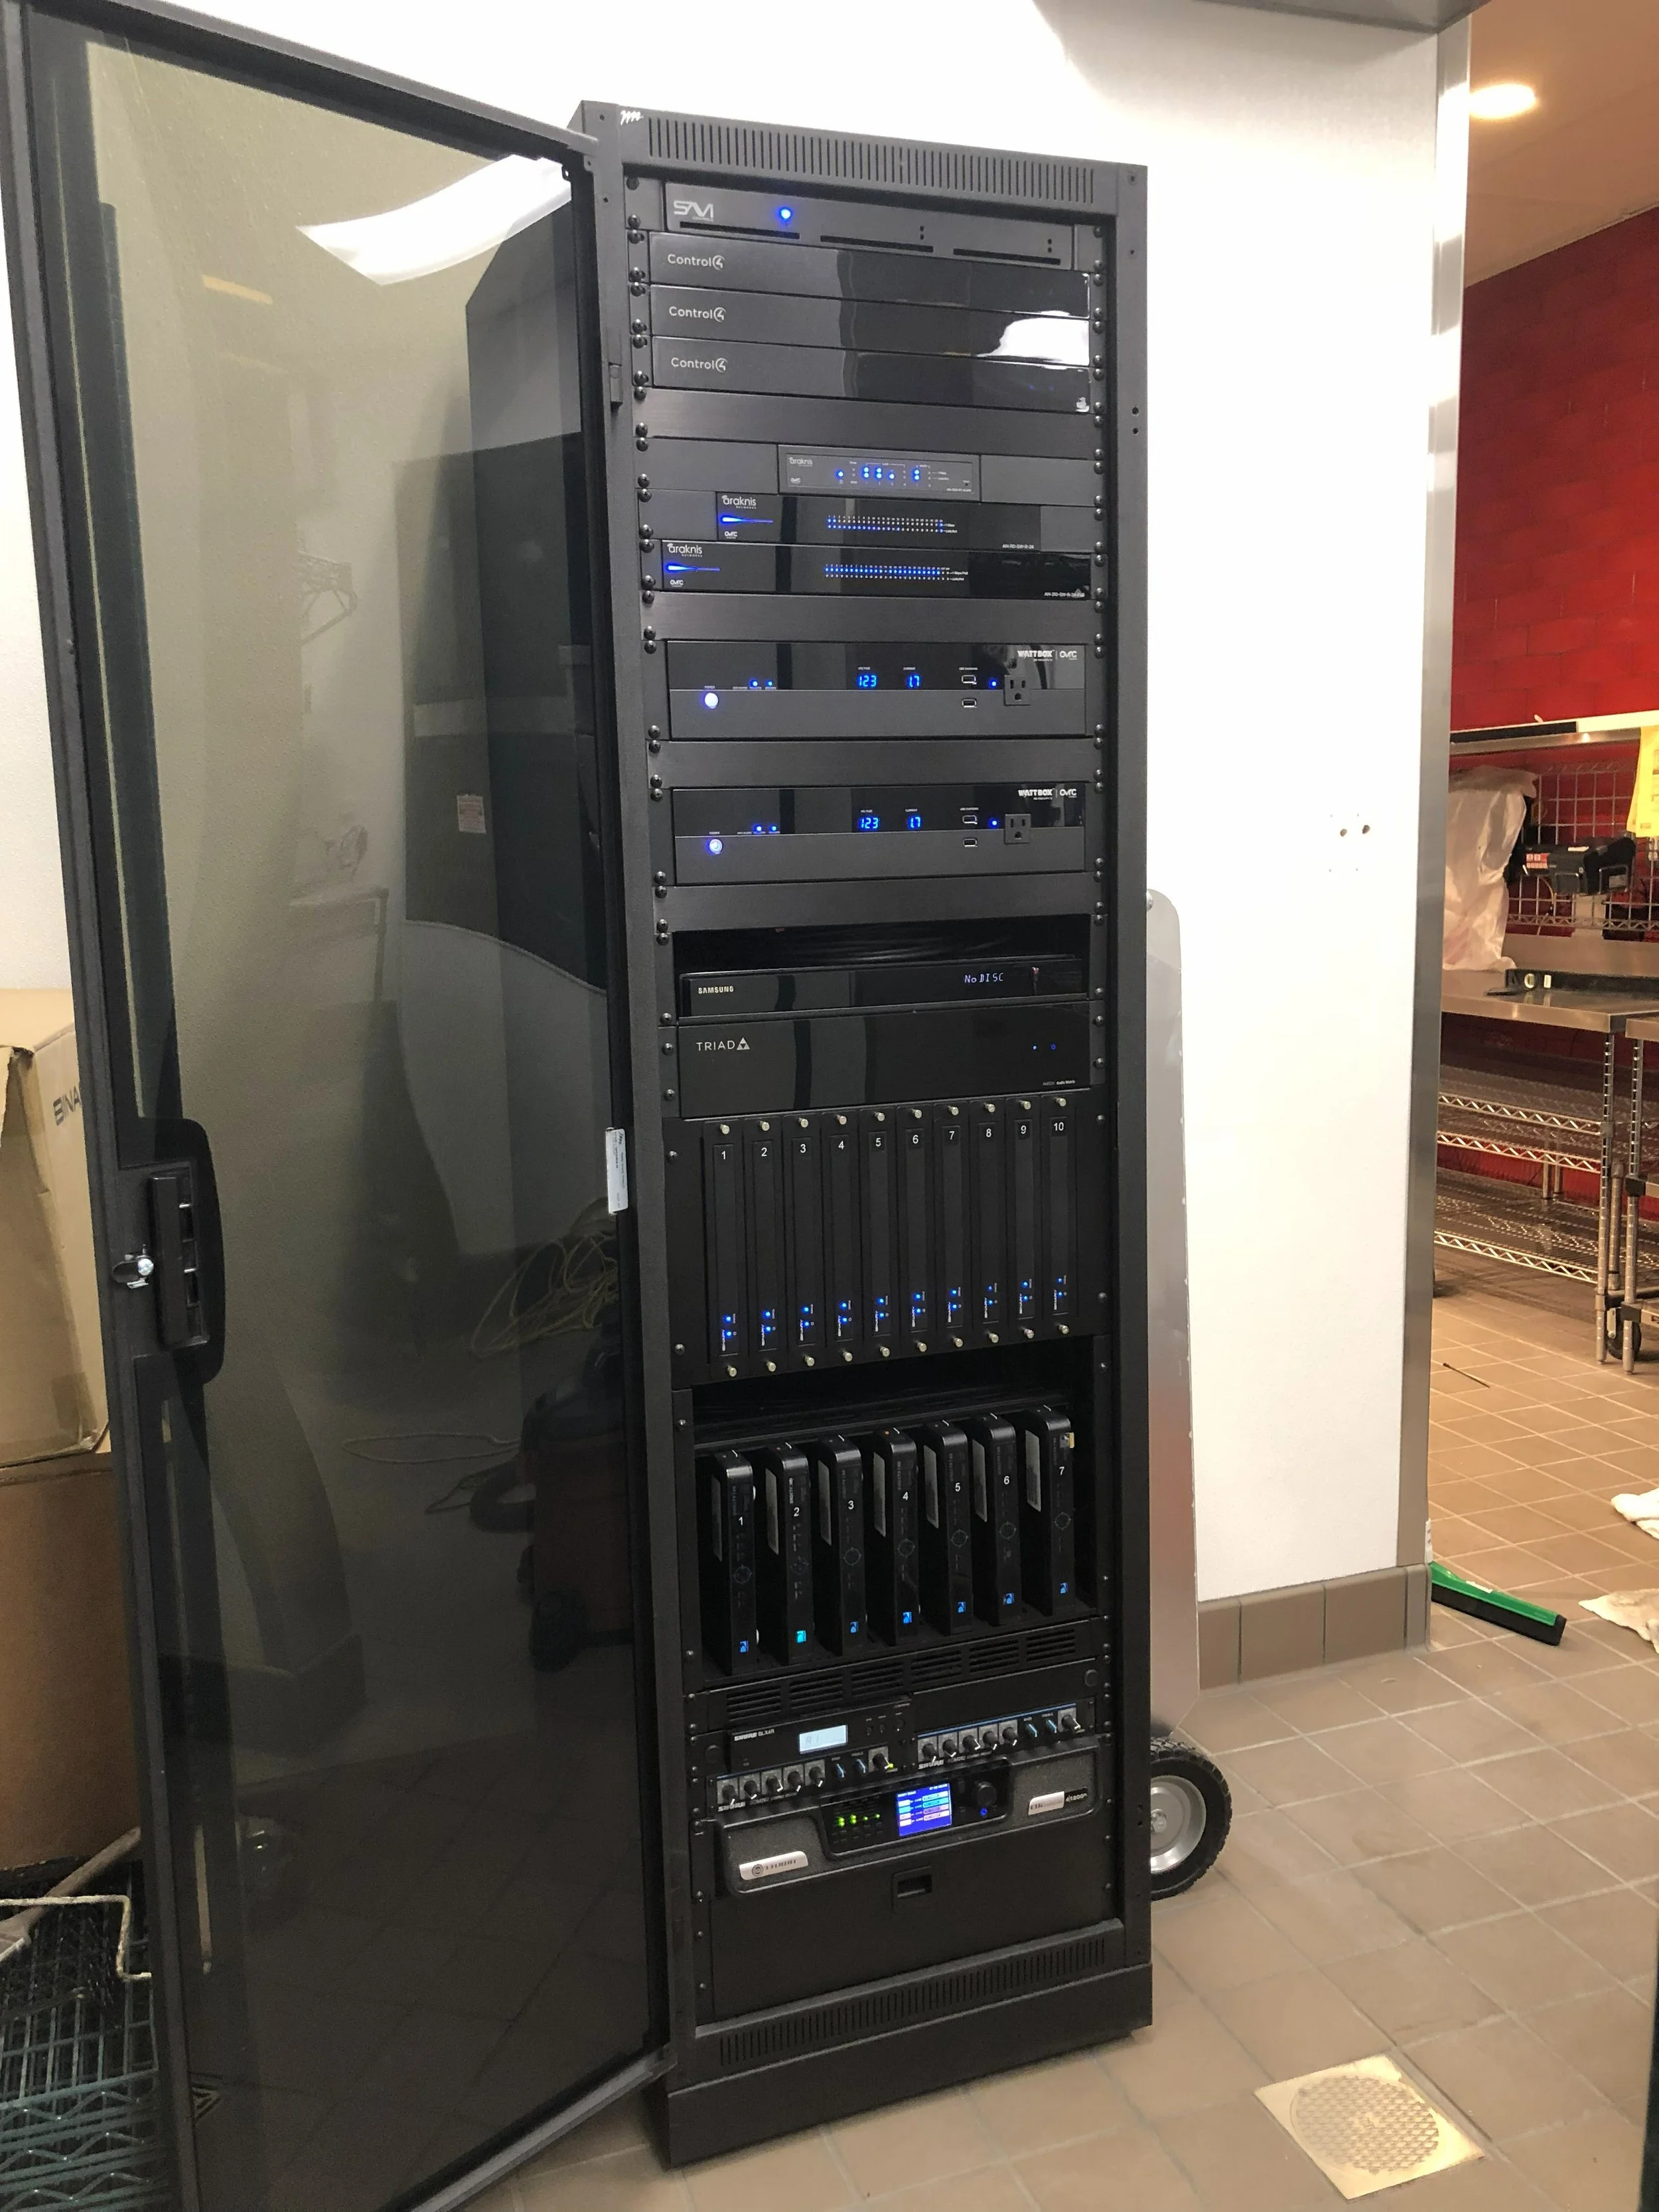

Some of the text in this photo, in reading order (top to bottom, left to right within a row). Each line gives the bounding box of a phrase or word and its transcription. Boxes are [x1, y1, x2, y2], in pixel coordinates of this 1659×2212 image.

[722, 495, 757, 506] araknis
[668, 544, 703, 554] araknis
[859, 675, 877, 688] 123
[861, 817, 879, 829] 123
[964, 972, 1004, 983] No DISC
[698, 986, 734, 994] SAMSUNG
[695, 1040, 735, 1051] TRIAD
[1021, 1125, 1027, 1134] 9
[1054, 1122, 1064, 1132] 10
[949, 1131, 955, 1140] 7
[985, 1128, 992, 1138] 8
[875, 1138, 882, 1147] 5
[912, 1134, 919, 1144] 6
[800, 1143, 807, 1153] 3
[838, 1140, 845, 1150] 4
[721, 1150, 726, 1160] 1
[761, 1147, 768, 1157] 2
[1059, 1466, 1066, 1475] 7
[1003, 1475, 1010, 1485] 6
[955, 1482, 962, 1492] 5
[902, 1491, 909, 1501] 4
[848, 1500, 855, 1510] 3
[794, 1507, 800, 1516] 2
[739, 1516, 744, 1525] 1
